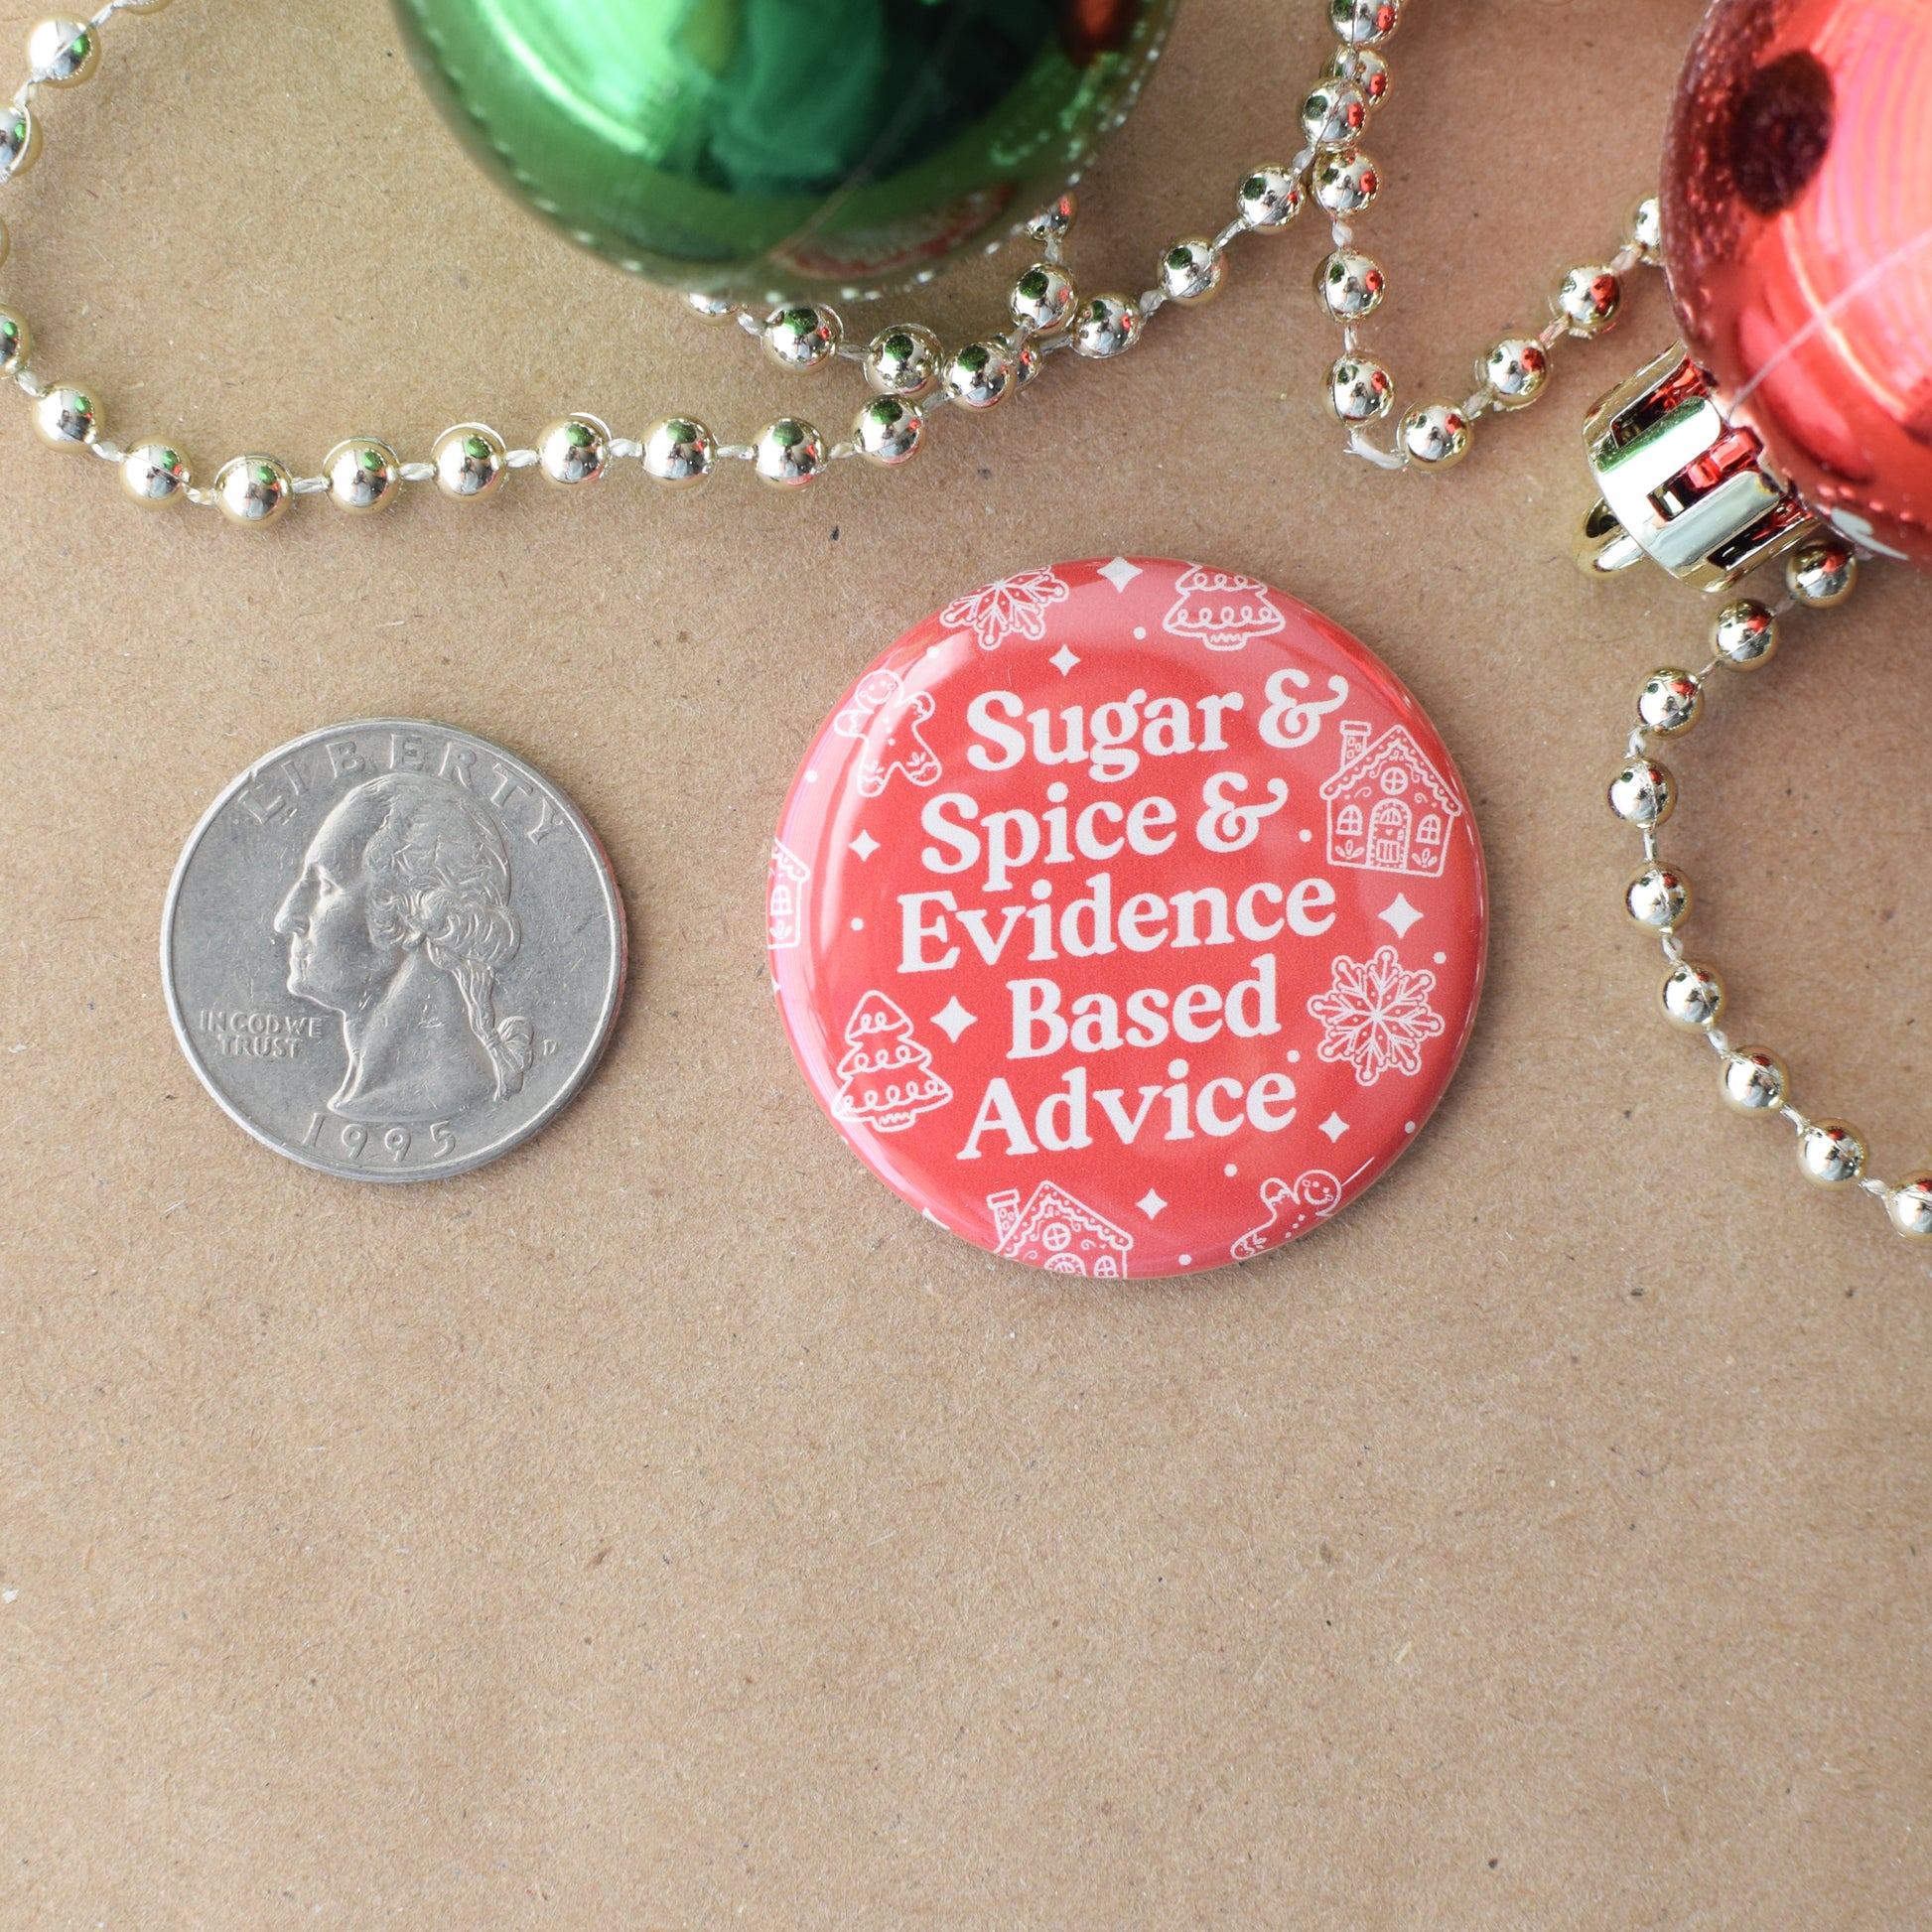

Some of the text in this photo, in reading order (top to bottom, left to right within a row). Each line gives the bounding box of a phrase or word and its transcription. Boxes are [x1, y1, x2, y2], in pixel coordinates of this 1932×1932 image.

[965, 668, 1349, 782] Sugar &
[238, 733, 566, 845] LIBERTY
[921, 771, 1289, 892] Spice &
[897, 873, 1336, 974] Evidence
[200, 1010, 324, 1038] IN GOD WE
[217, 1034, 302, 1059] TRUST
[1006, 953, 1281, 1059] Based
[301, 1112, 457, 1162] 1995
[956, 1057, 1297, 1160] Advice
